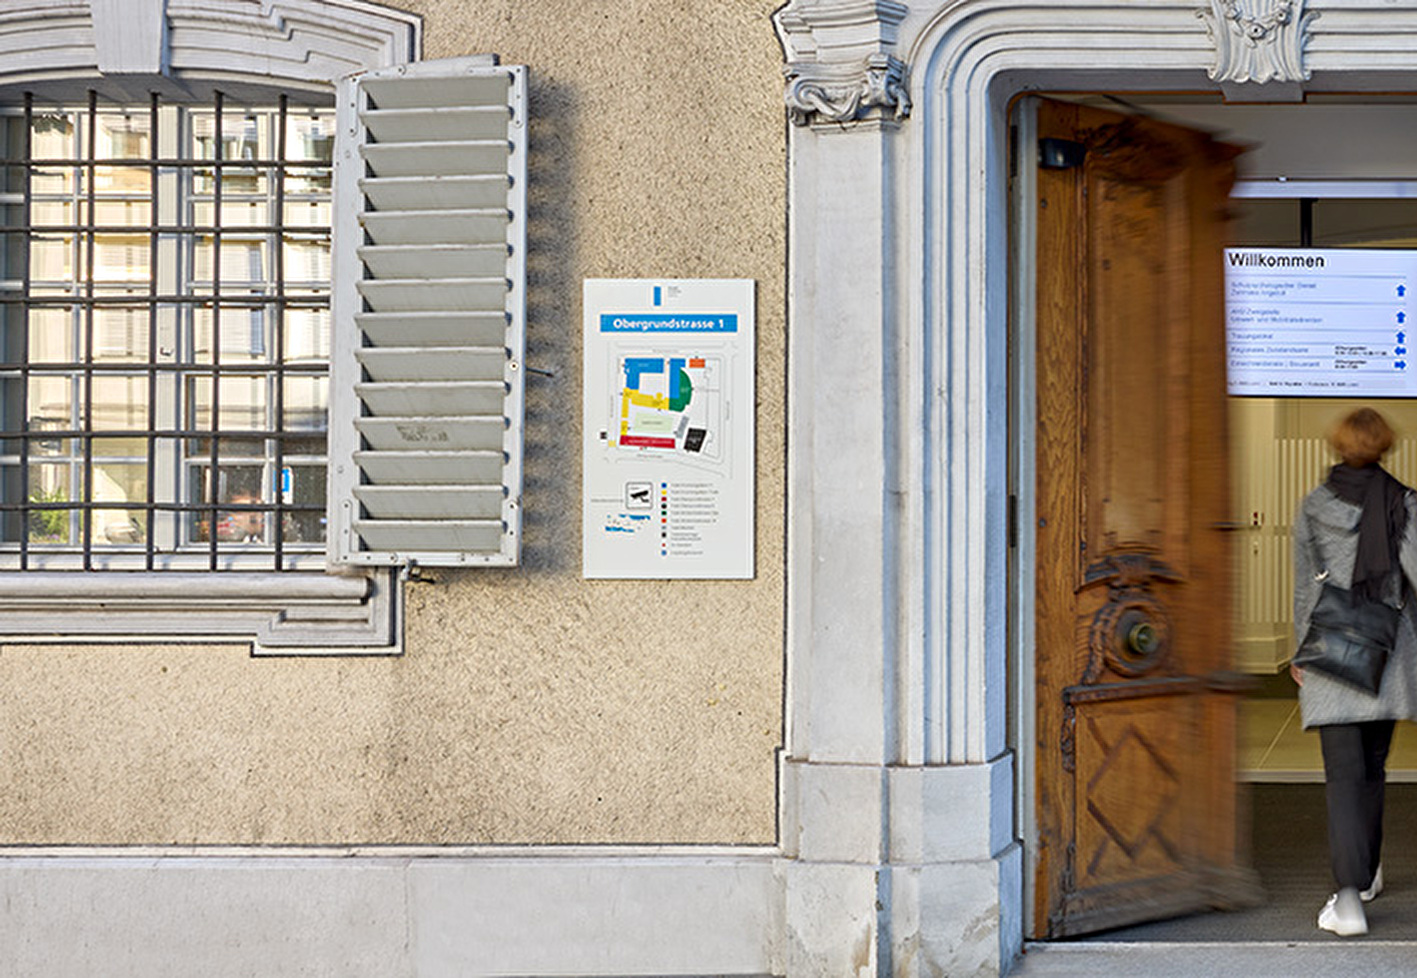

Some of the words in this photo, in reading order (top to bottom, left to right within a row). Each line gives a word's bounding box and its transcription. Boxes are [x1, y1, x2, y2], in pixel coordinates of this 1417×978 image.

[1229, 253, 1325, 268] Willkommen
[613, 318, 715, 331] Obergrundstrasse
[718, 319, 725, 329] 1
